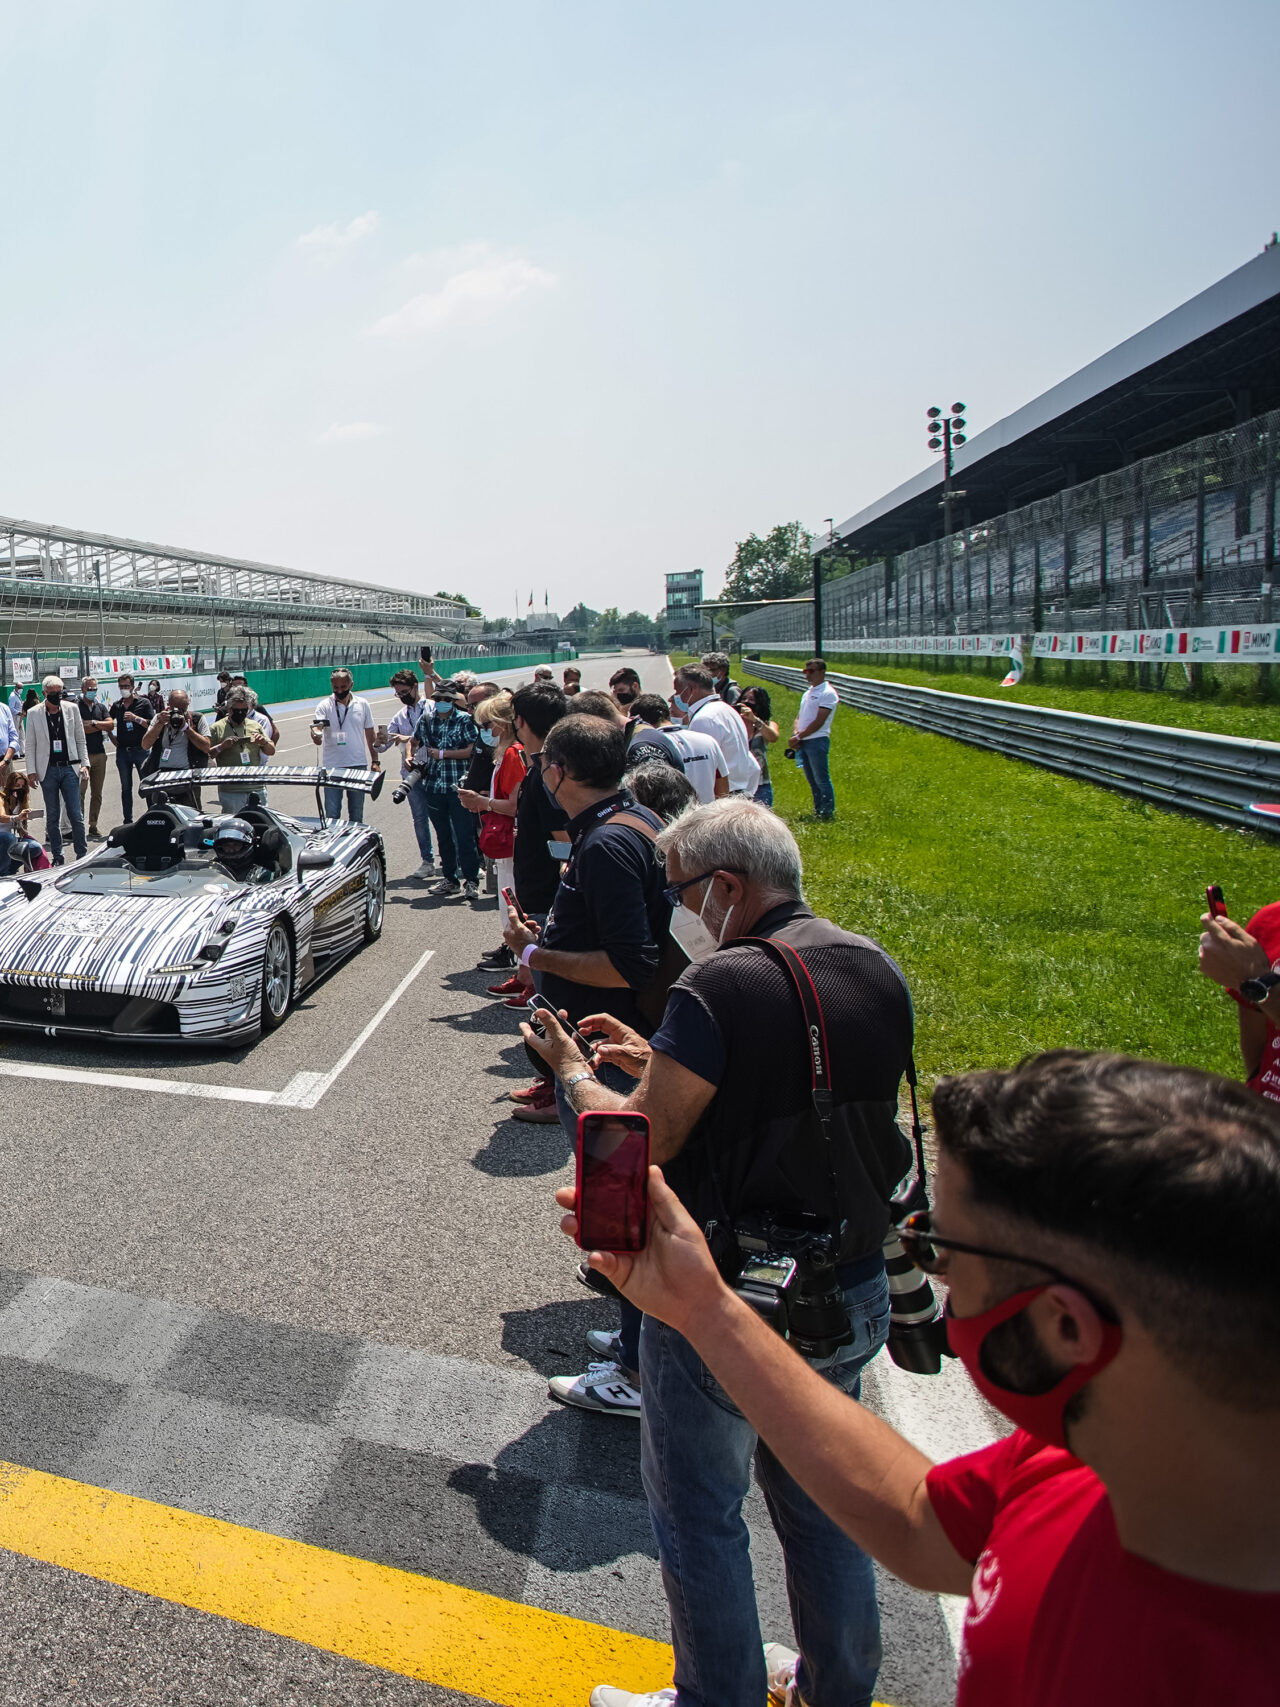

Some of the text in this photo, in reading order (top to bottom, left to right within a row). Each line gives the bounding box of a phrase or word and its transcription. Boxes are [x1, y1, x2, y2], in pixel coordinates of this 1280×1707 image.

[1252, 633, 1271, 648] MIMO
[809, 1024, 822, 1075] Canon
[606, 1384, 634, 1400] H
